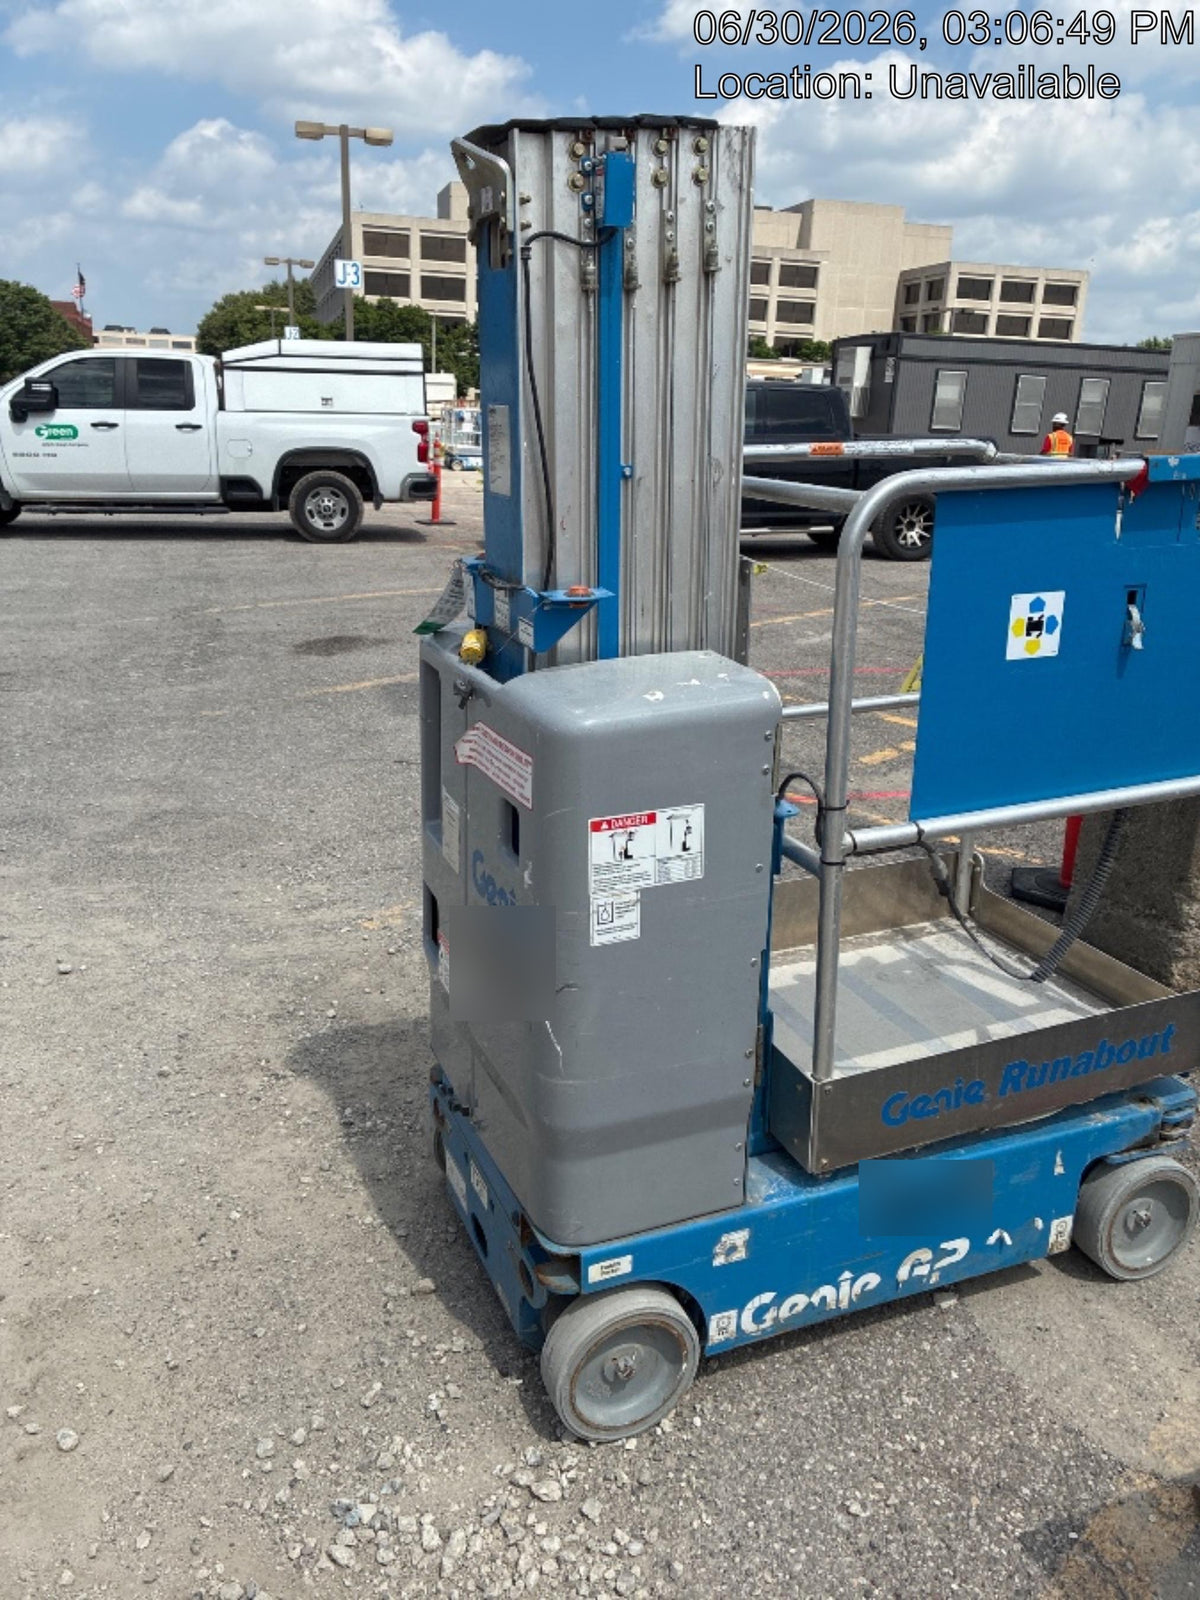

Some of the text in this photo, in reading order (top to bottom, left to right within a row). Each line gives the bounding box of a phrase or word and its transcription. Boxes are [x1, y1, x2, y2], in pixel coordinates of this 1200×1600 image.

[36, 424, 74, 440] Green
[610, 815, 649, 829] DANGER
[881, 1023, 1175, 1127] Genie Runabout
[740, 1270, 882, 1336] Genie
